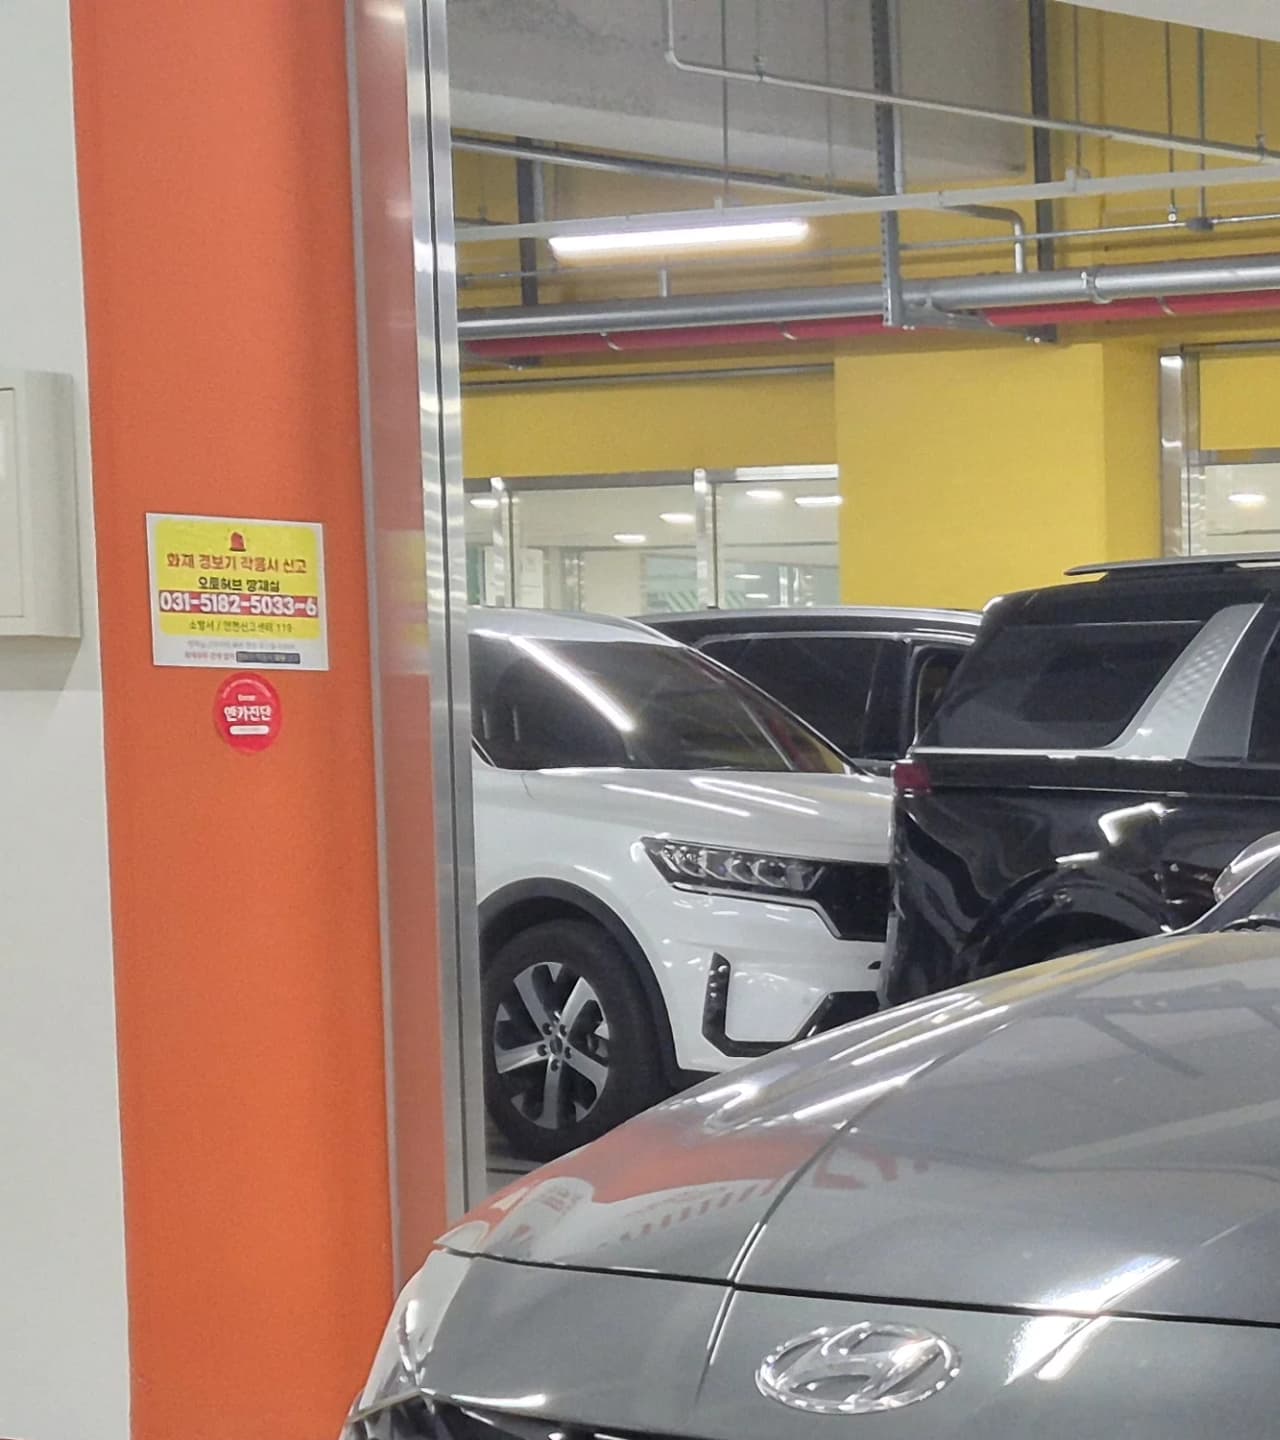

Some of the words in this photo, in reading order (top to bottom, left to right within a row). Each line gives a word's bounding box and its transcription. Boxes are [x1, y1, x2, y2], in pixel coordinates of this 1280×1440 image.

[167, 553, 194, 568] 화재
[199, 554, 237, 570] 경보기
[240, 556, 279, 573] 작동시
[283, 559, 307, 574] 신고
[198, 576, 242, 591] 오토허브
[246, 578, 280, 593] 방재실
[160, 591, 317, 616] 031-5182-5033-6
